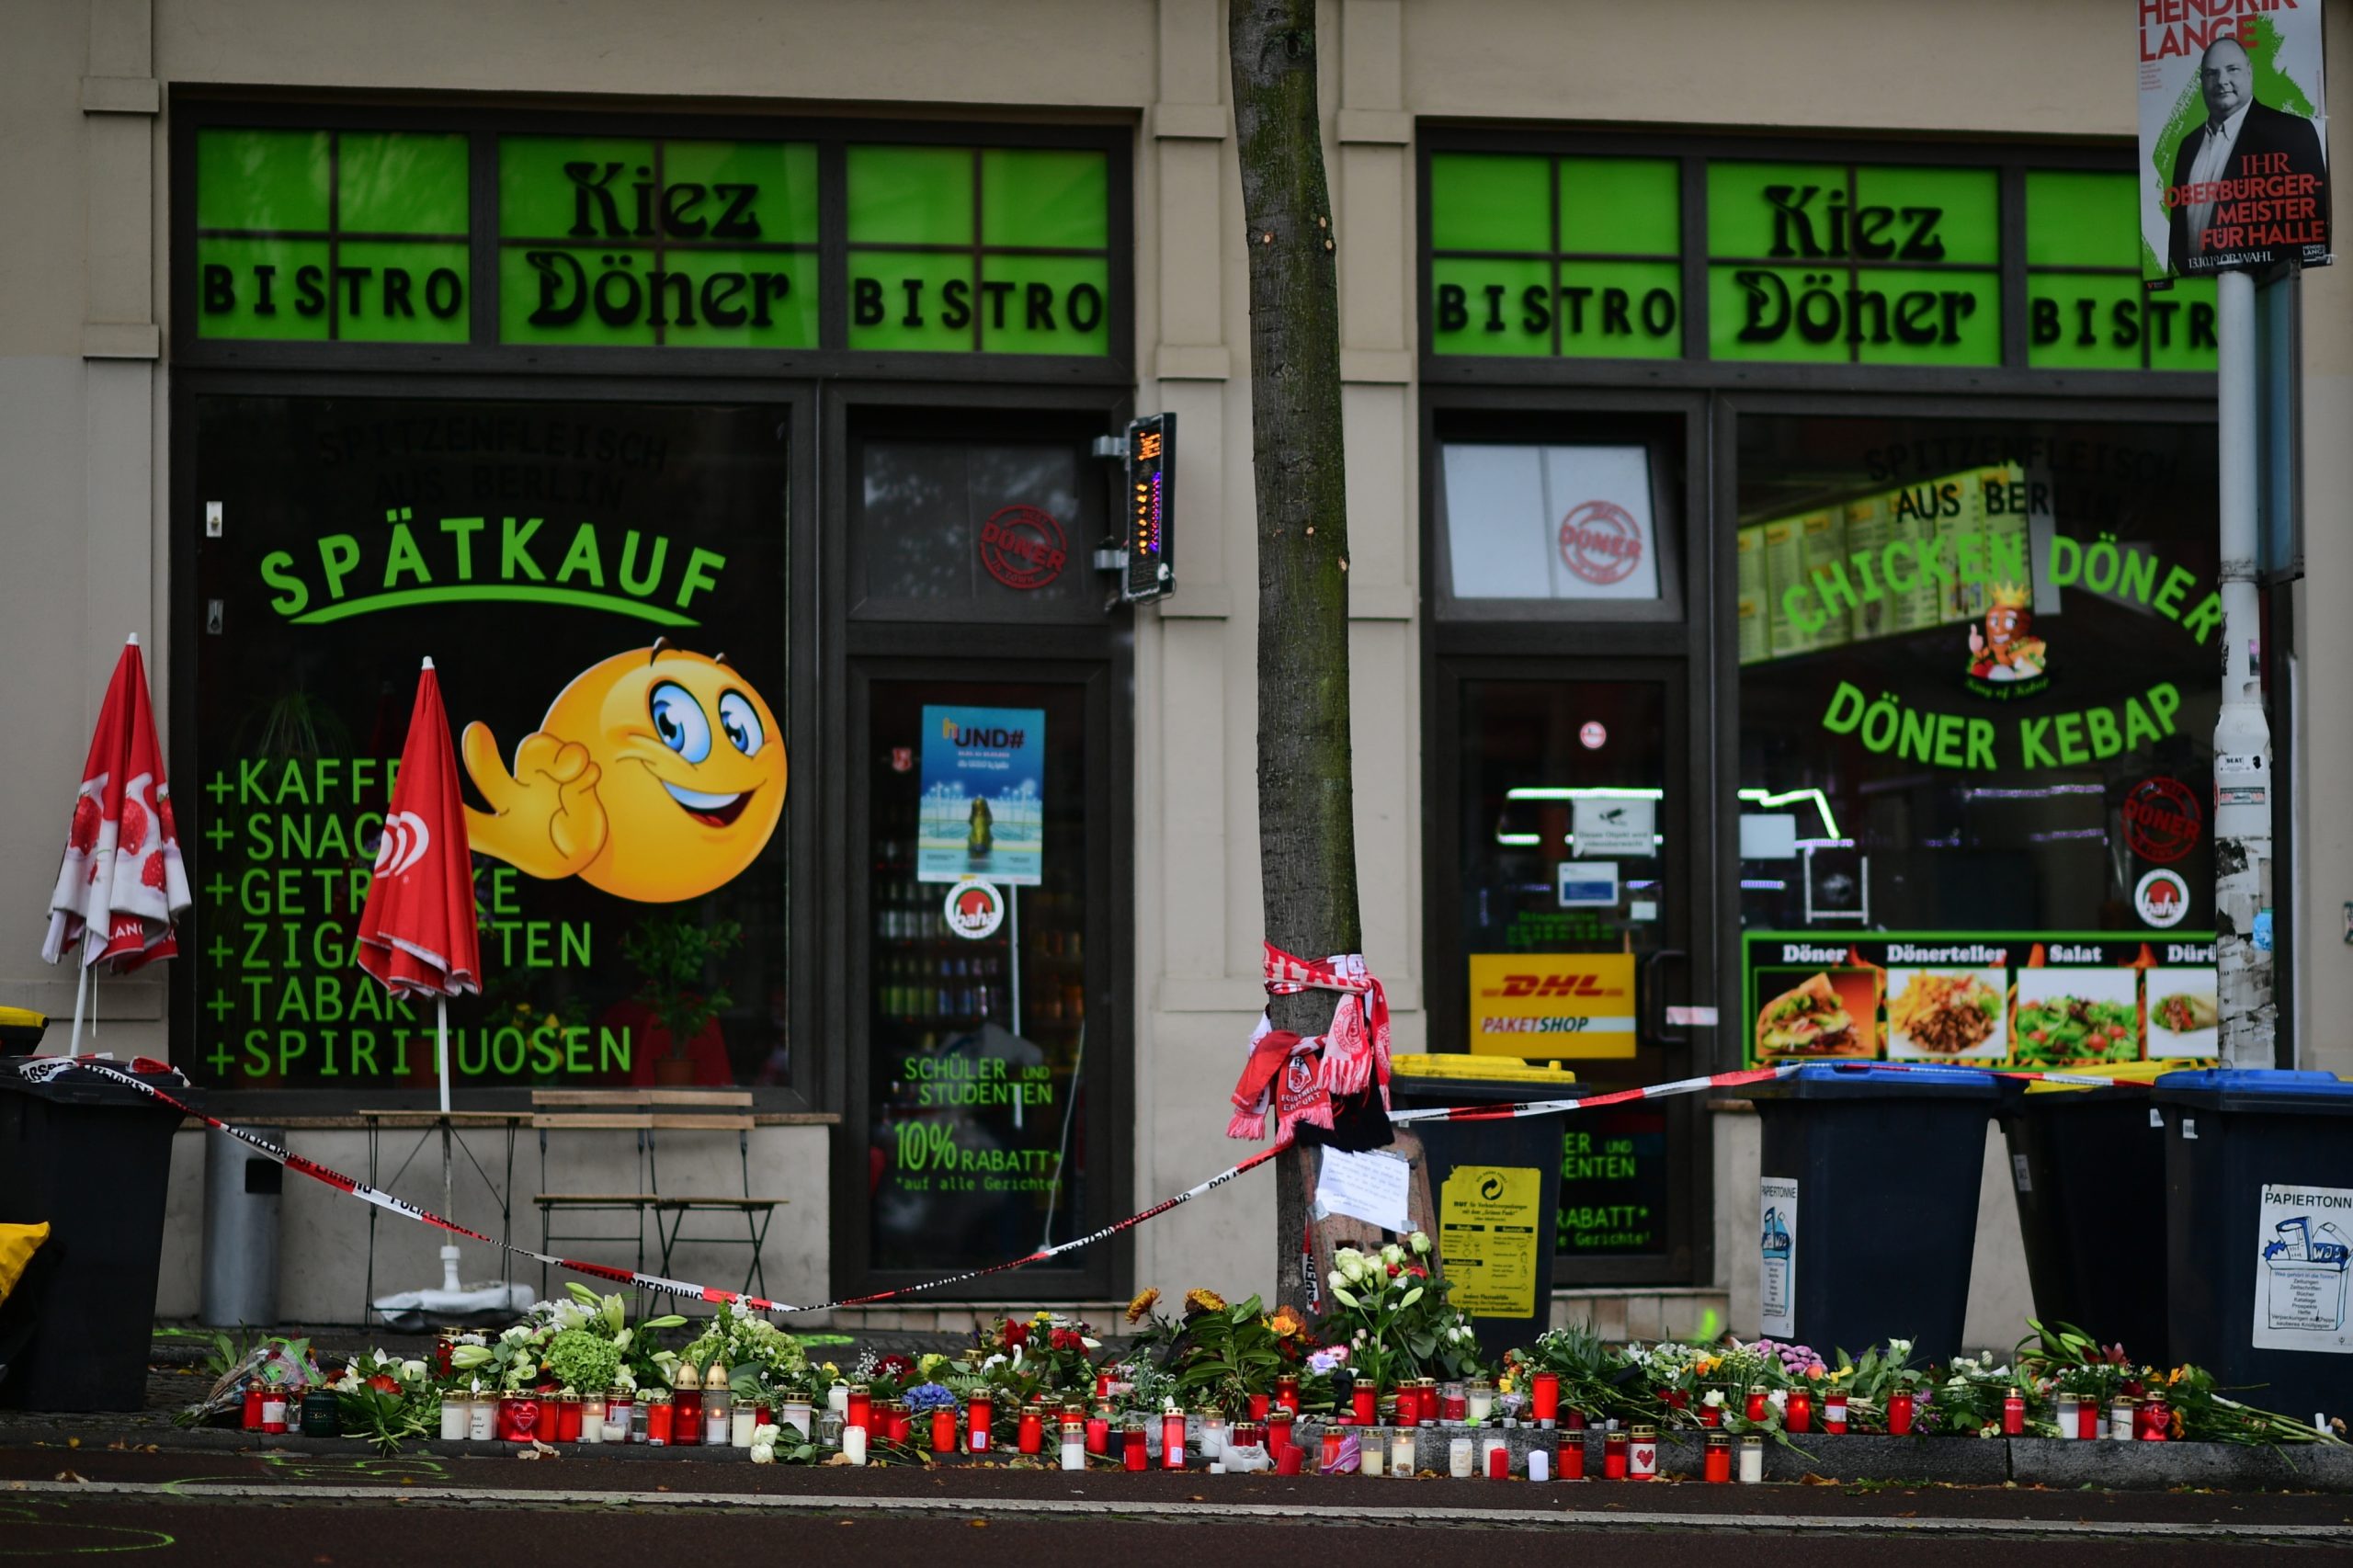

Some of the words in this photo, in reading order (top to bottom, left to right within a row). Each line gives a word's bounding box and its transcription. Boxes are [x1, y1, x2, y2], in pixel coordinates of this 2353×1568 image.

[2139, 0, 2298, 27] HEND
[2241, 153, 2292, 176] IHR
[563, 160, 762, 239] Kiez
[2164, 174, 2323, 209] OBERBÜRGER-
[1763, 184, 1947, 262] Kiez
[2216, 199, 2316, 226] MEISTER
[2199, 227, 2244, 251] FÜR
[2248, 221, 2325, 245] HALLE
[203, 263, 465, 320] BISTRO
[525, 249, 790, 328] Döner
[854, 278, 1102, 333] BISTRO
[1437, 283, 1678, 337] BISTRO
[1735, 269, 1977, 347] Döner
[2030, 297, 2218, 350] BISTR
[1896, 483, 1961, 523] AUS
[260, 506, 726, 616] SPÄTKAUF
[1782, 532, 2023, 633] CHICKEN
[2048, 531, 2222, 645] DÖNER
[1823, 681, 1996, 770] DÖNER
[2021, 682, 2181, 770] KEBAP
[1783, 944, 1847, 963] Döner
[1887, 944, 2006, 963] Dönerteller
[2049, 944, 2102, 963] Salat
[2167, 944, 2216, 962] Dürü
[1501, 974, 1604, 997] DHL
[1482, 1016, 1589, 1033] PAKETSHOP
[904, 1052, 1006, 1080] SCHÜLER
[1022, 1065, 1051, 1080] UND
[919, 1083, 1053, 1106] STUDENTEN
[1283, 1093, 1321, 1111] ERFURT
[894, 1121, 957, 1170] 10%
[940, 1176, 975, 1190] alle
[1562, 1157, 1635, 1179] ENTEN
[2265, 1192, 2353, 1210] PAPIERTONN
